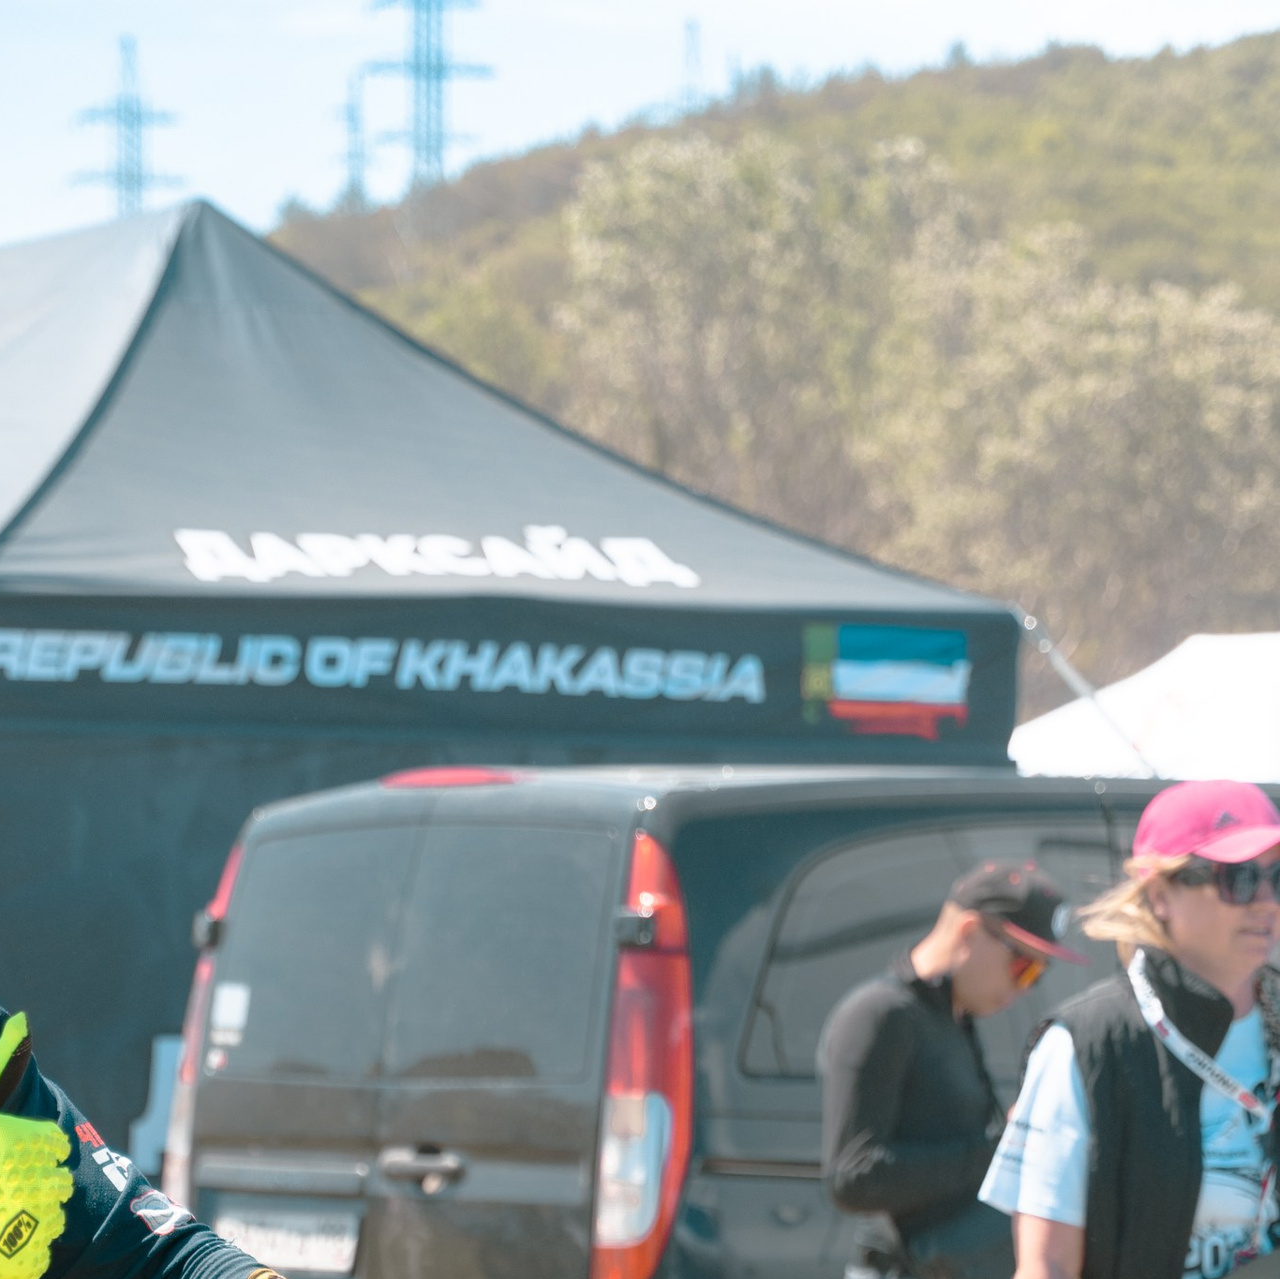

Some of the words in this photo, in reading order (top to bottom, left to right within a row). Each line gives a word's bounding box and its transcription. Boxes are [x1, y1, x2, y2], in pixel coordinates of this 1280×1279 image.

[304, 641, 394, 690] OF
[397, 641, 766, 704] KHAKASSIA
[2, 1217, 32, 1253] 100%
